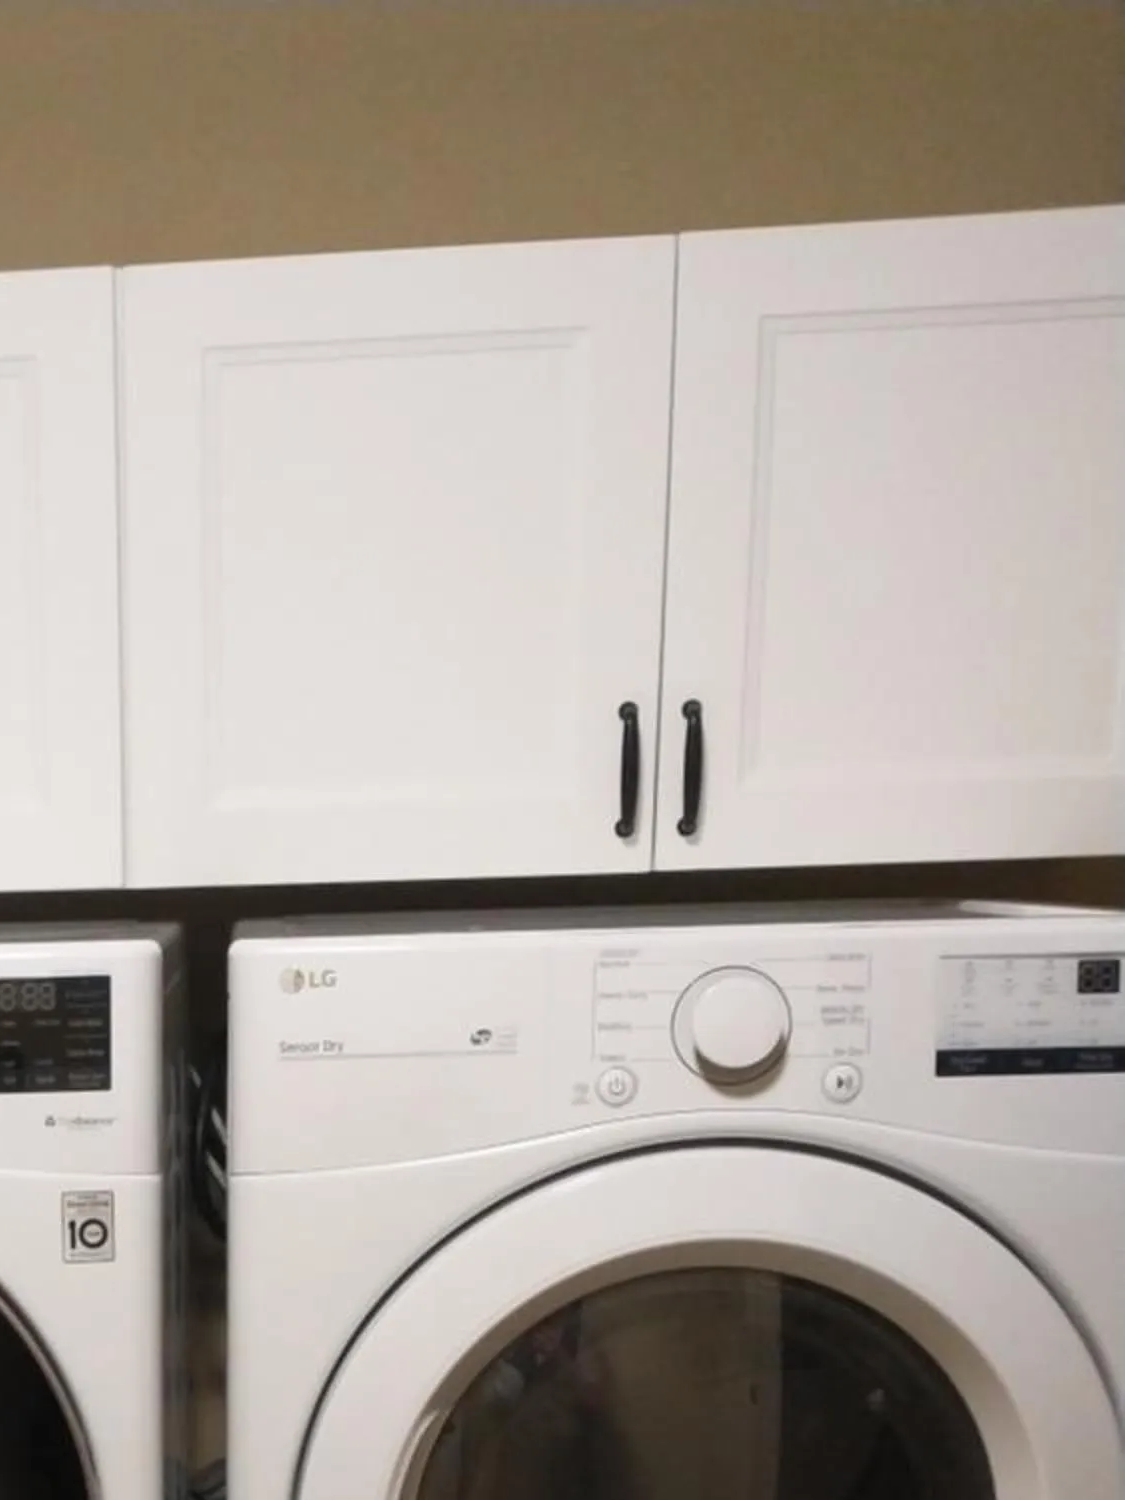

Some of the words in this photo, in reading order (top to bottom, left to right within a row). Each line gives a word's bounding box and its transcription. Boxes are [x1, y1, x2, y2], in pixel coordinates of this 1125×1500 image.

[308, 969, 337, 988] LG
[279, 1040, 320, 1053] Sensor
[322, 1039, 344, 1053] Dry
[68, 1218, 109, 1249] 10
